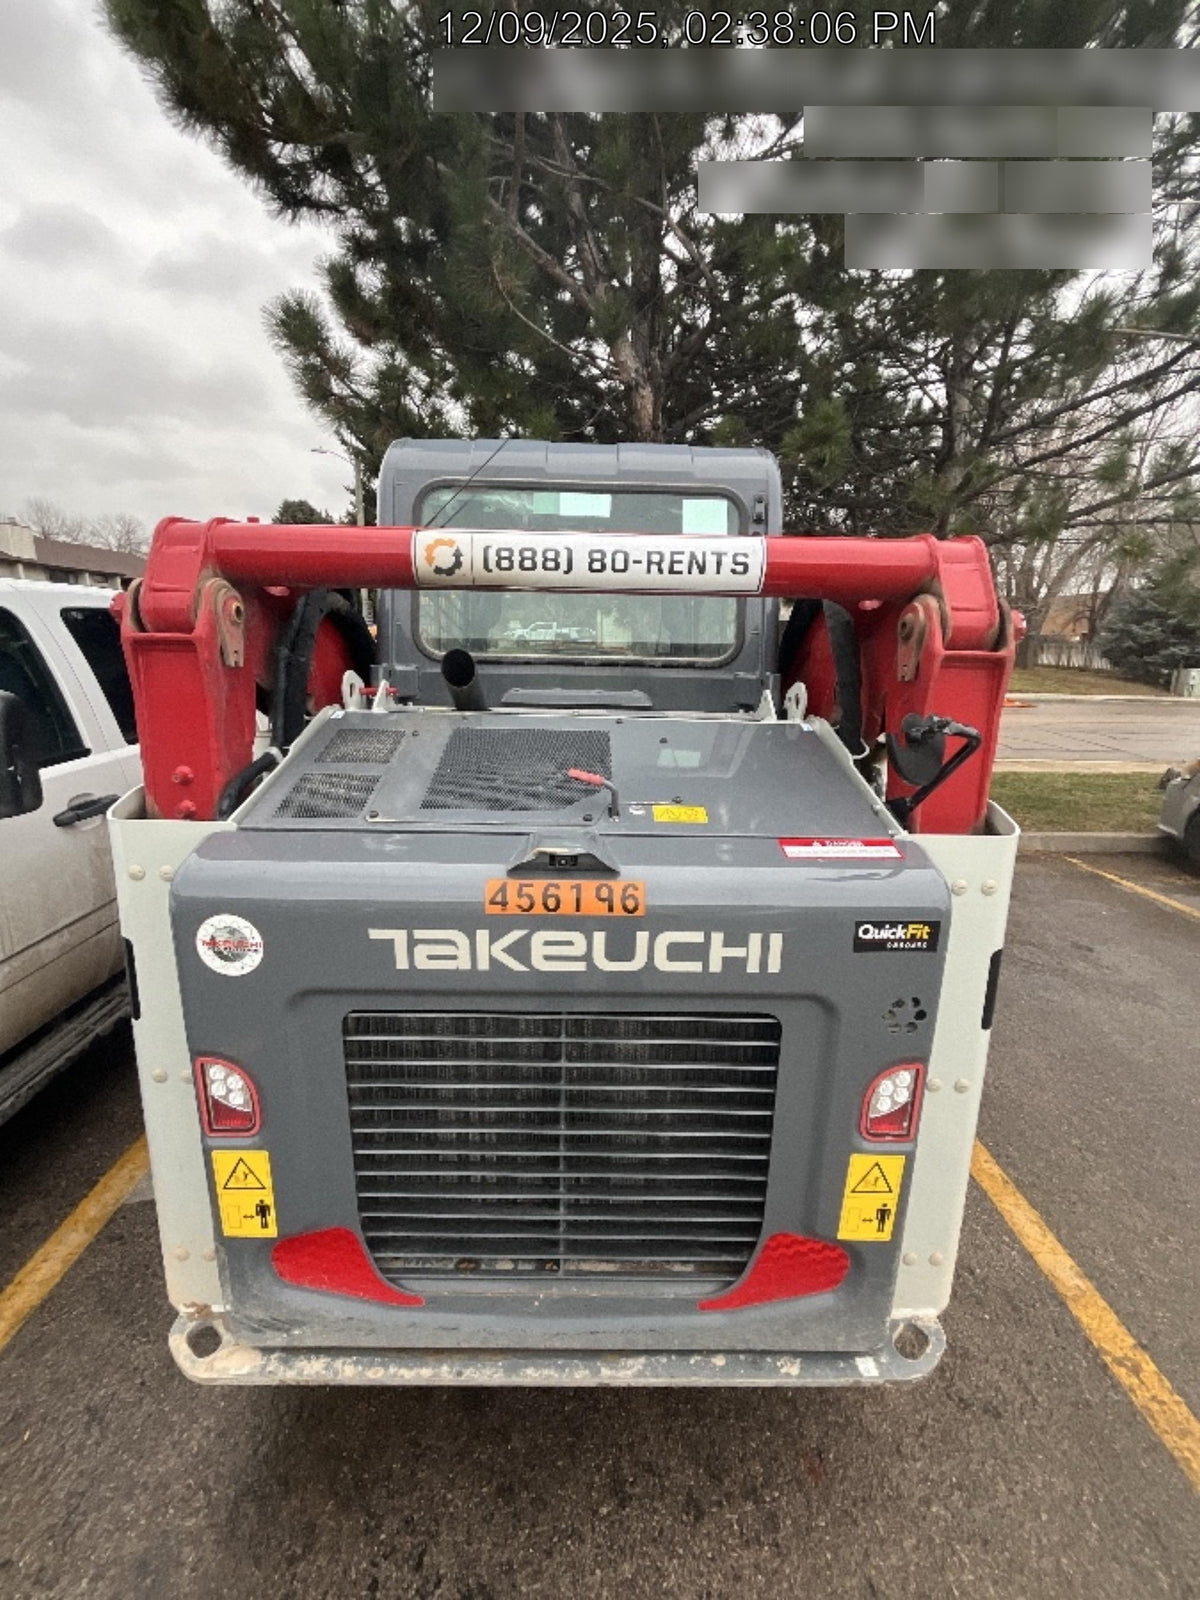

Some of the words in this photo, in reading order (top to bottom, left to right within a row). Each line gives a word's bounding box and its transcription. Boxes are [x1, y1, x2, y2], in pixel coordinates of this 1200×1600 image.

[482, 544, 574, 575] (888)
[587, 549, 751, 576] 80-RENTS
[488, 881, 640, 914] 456196
[858, 923, 931, 940] QuickFit
[367, 928, 783, 973] TAKEUCHI
